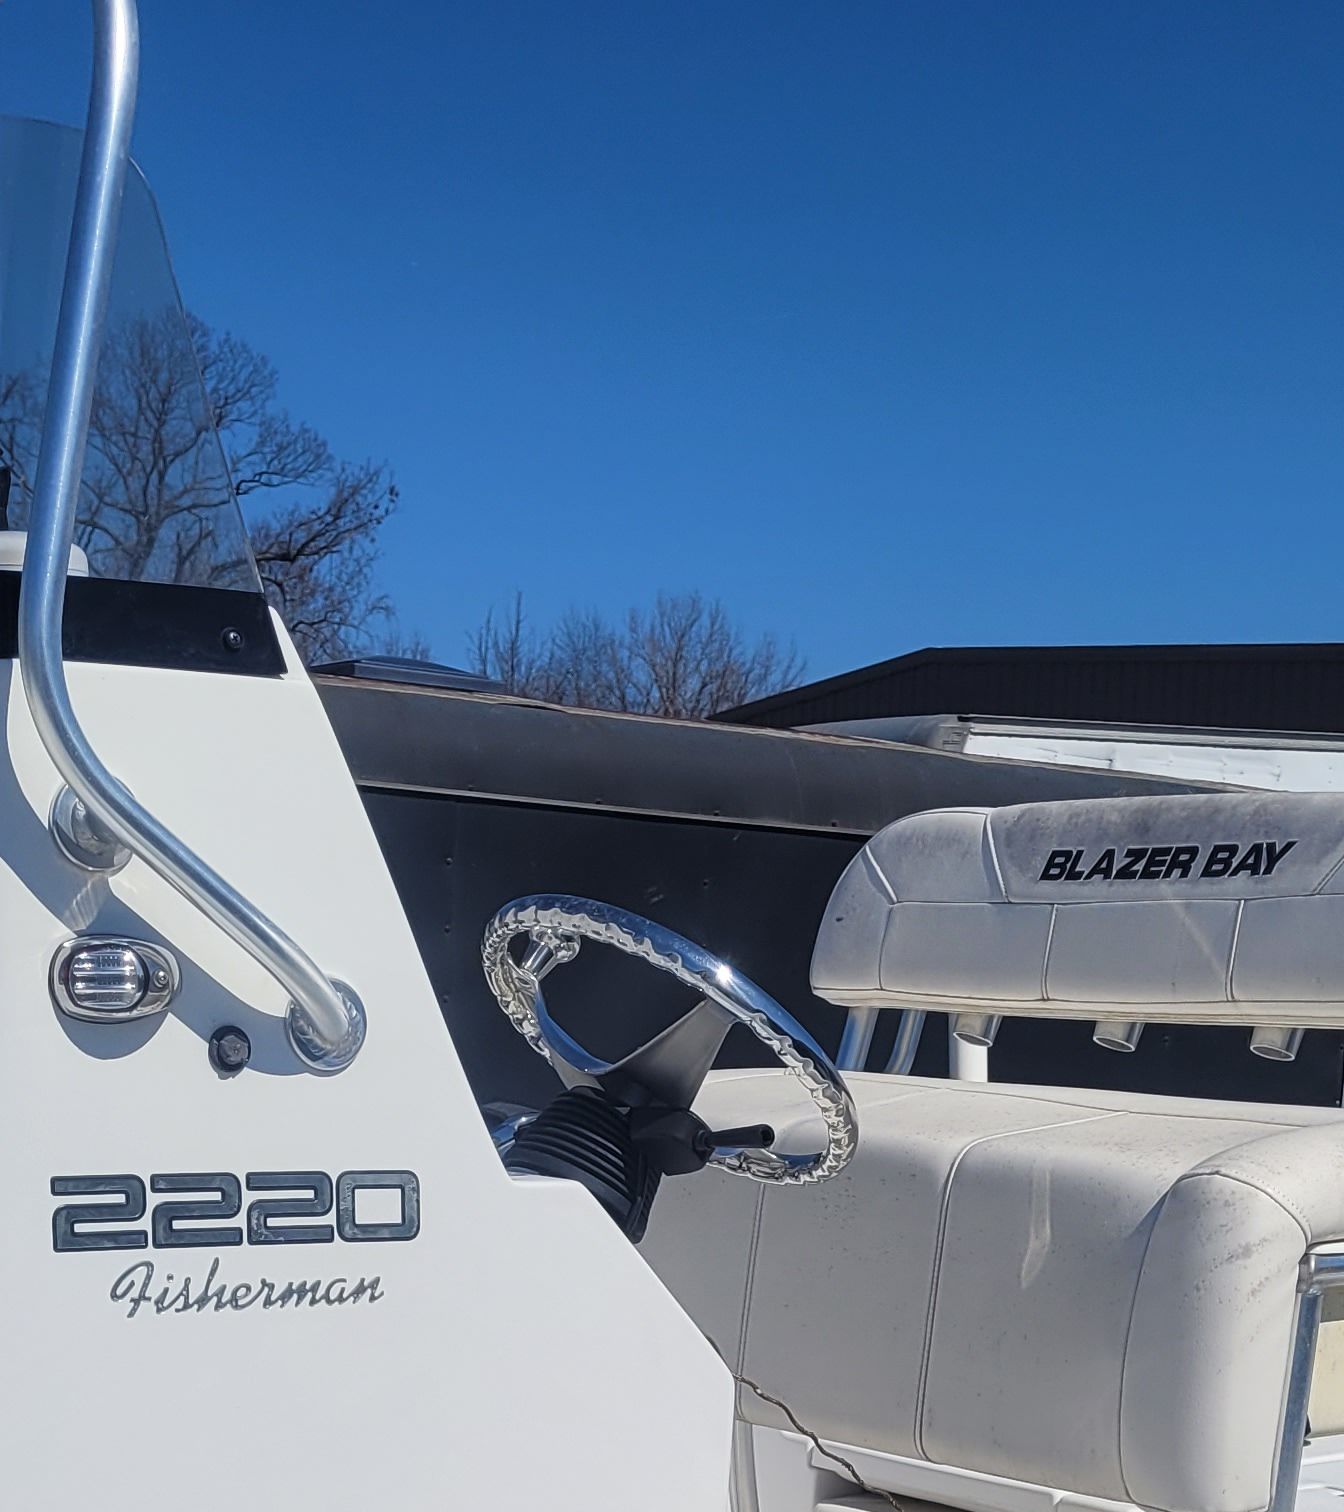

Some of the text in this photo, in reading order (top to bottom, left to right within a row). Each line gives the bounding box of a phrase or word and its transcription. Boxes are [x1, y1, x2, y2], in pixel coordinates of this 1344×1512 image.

[1037, 839, 1300, 882] BLAZER BAY
[50, 1169, 421, 1253] 2220
[109, 1256, 385, 1319] Fisherman
